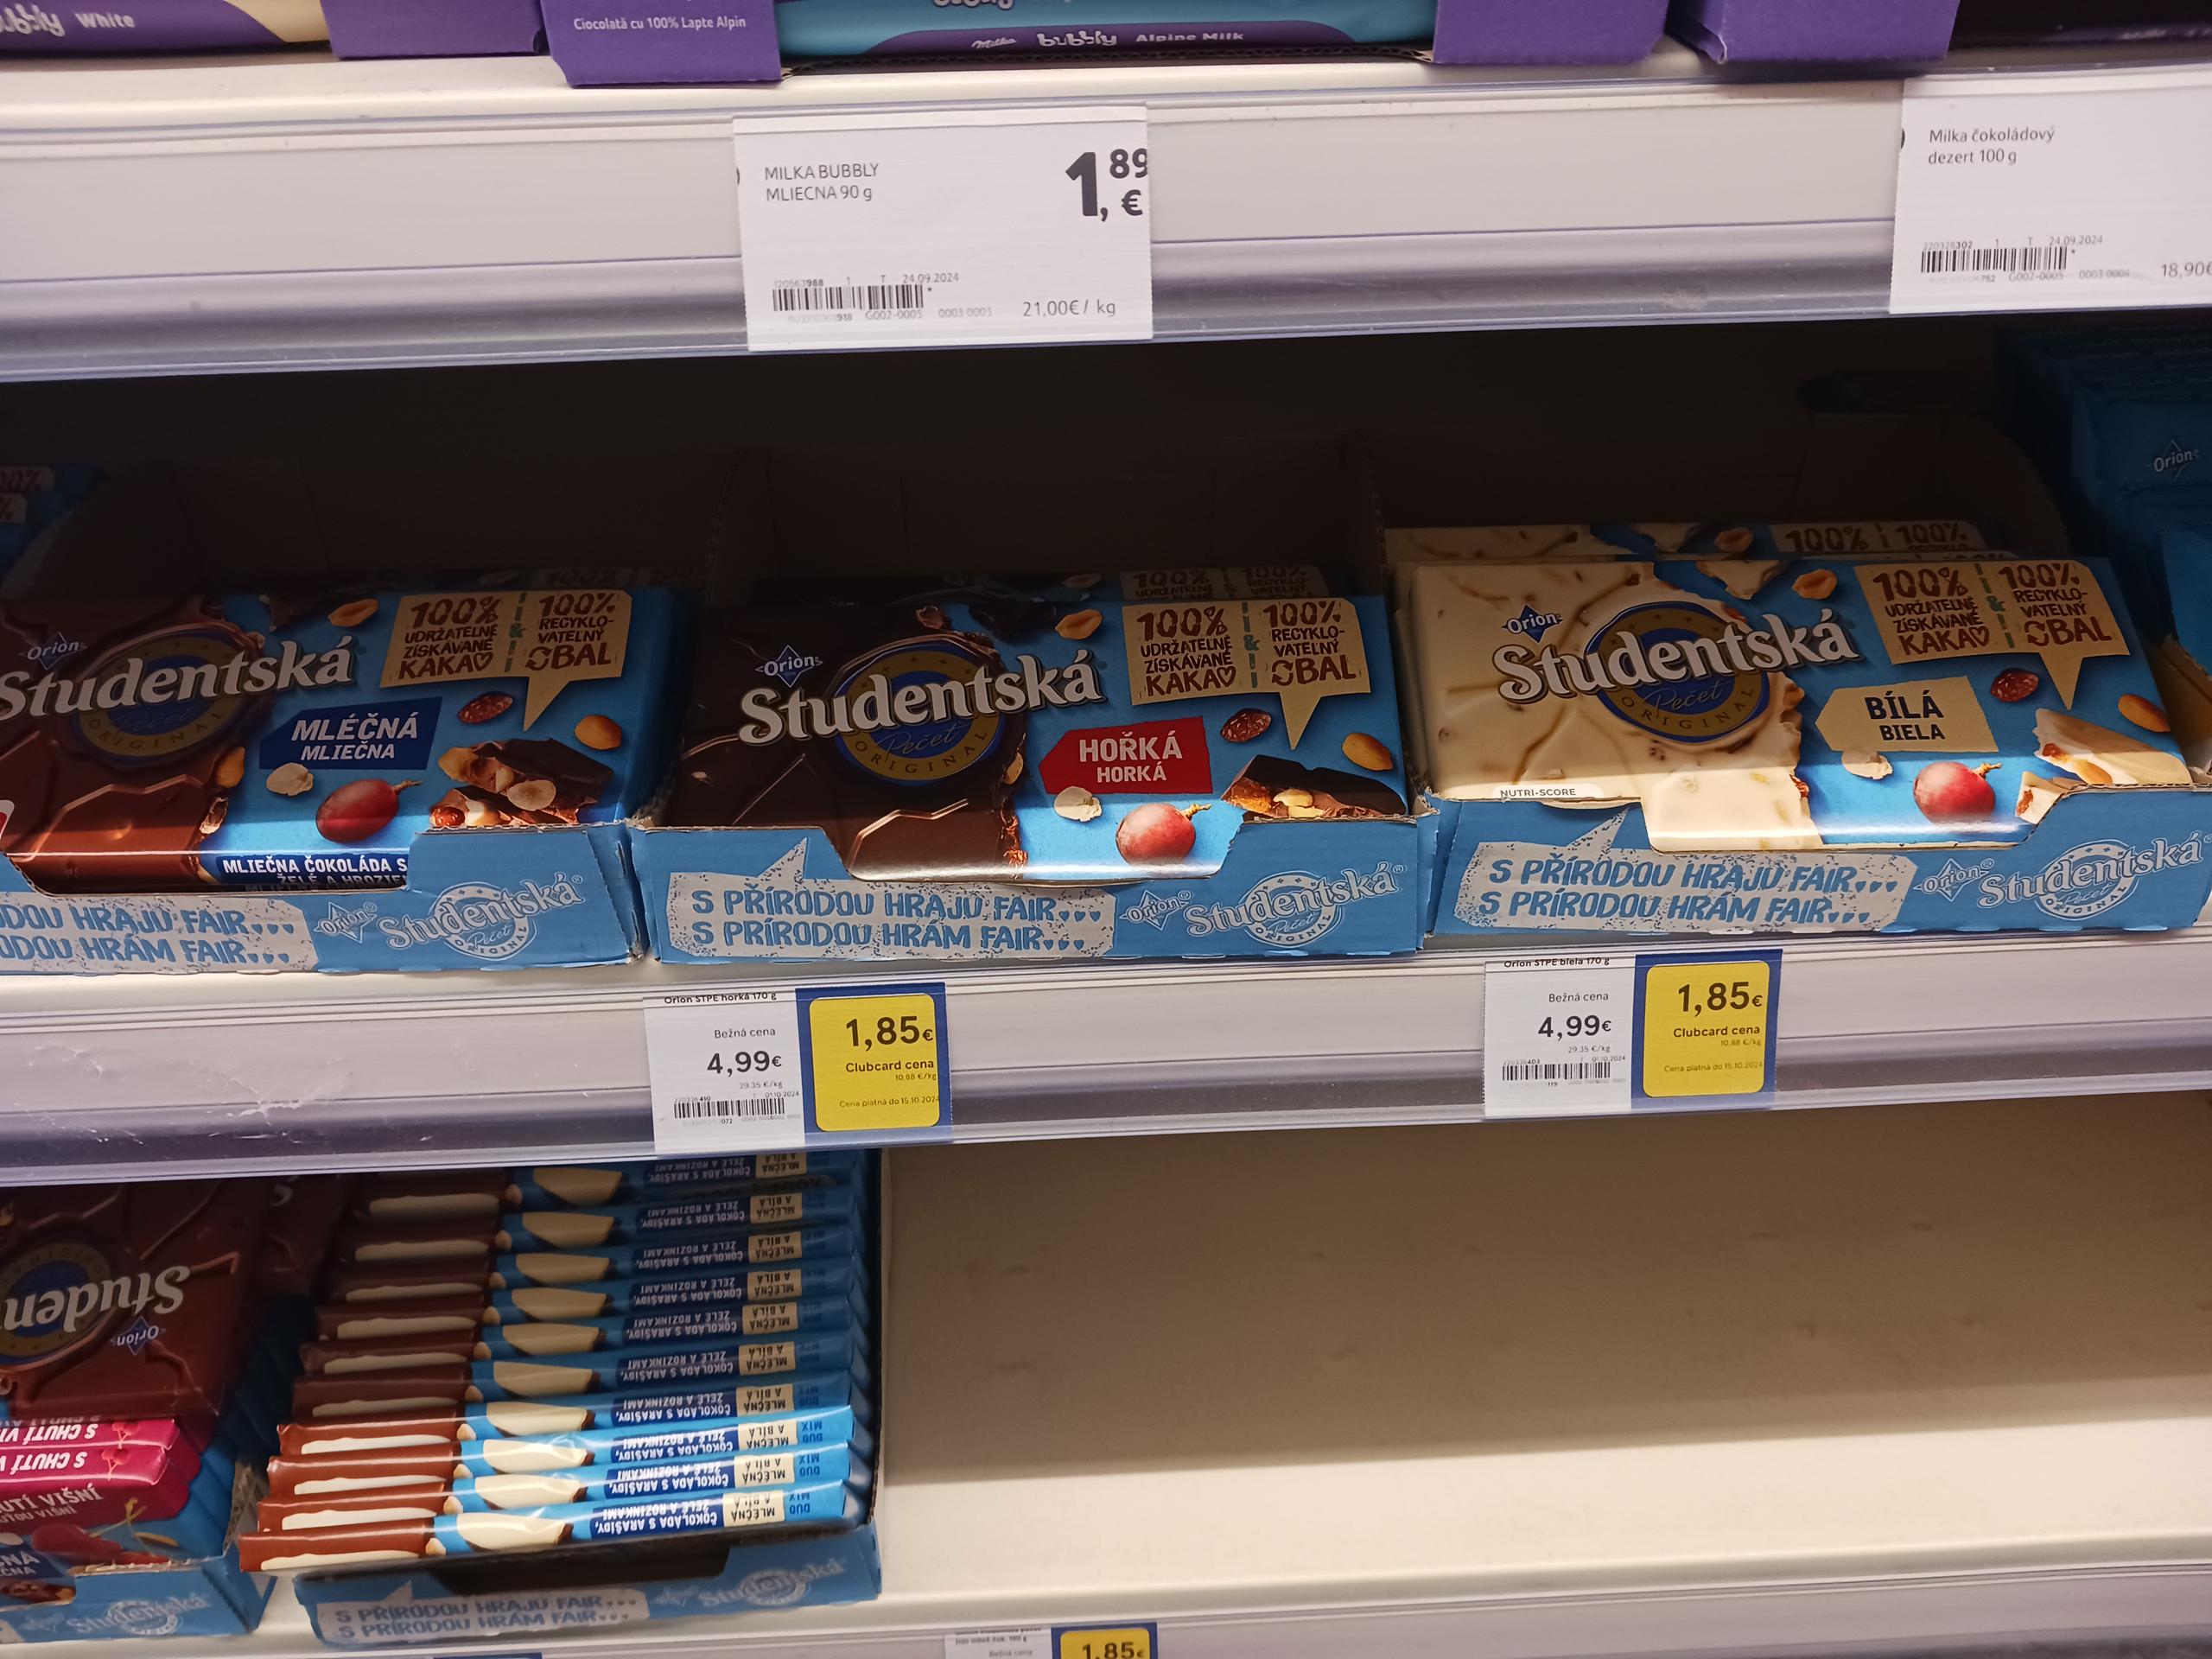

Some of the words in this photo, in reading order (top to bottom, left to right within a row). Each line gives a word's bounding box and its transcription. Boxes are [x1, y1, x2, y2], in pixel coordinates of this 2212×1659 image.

[74, 12, 135, 28] White
[574, 17, 627, 30] Ciocolată
[631, 19, 645, 29] cu
[646, 16, 679, 29] 100%
[681, 16, 714, 31] Lapte
[716, 15, 747, 31] Alpin
[971, 38, 1017, 49] Milka
[1037, 30, 1117, 47] bubbly
[1135, 33, 1198, 42] Alpine
[1202, 32, 1244, 41] Milk
[1929, 129, 1967, 143] Milka
[1972, 125, 2055, 144] čokoládový
[1928, 150, 1974, 164] dezert
[1980, 148, 2005, 162] 100
[2008, 151, 2017, 165] g
[765, 165, 816, 180] MILKA
[818, 162, 879, 179] BUBBLY
[766, 186, 838, 201] MLIECNA
[840, 185, 859, 199] 90
[863, 188, 873, 201] g
[1122, 189, 1143, 216] €
[2049, 235, 2103, 246] 24.09.2024
[903, 273, 959, 284] 24.09.2024
[1097, 299, 1116, 316] kg
[2152, 449, 2193, 473] Orion
[1783, 525, 1867, 552] 100%
[1897, 522, 1967, 543] 100%
[1872, 567, 1968, 601] 100%
[1999, 563, 2080, 589] 100%
[2012, 588, 2088, 603] RECYKLO-
[410, 595, 501, 629] 100%
[538, 593, 615, 617] 100%
[1136, 606, 1228, 641] 100%
[1262, 601, 1341, 628] 100%
[539, 615, 615, 630] RECYKLO-
[1506, 612, 1558, 635] Orion
[1271, 626, 1345, 642] RECYKLO-
[27, 640, 79, 662] Orion
[1493, 608, 1859, 704] Studentská
[764, 656, 816, 677] Orion
[0, 636, 354, 721] Studentská
[738, 649, 1103, 745] Studentská
[1865, 690, 1944, 720] BÍLÁ
[1620, 688, 1756, 730] ORIGINAL
[291, 712, 419, 741] MLÉČNÁ
[1879, 724, 1945, 741] BIELA
[300, 741, 395, 761] MLIEČNA
[855, 732, 988, 775] ORIGINAL
[1078, 730, 1183, 764] HOŘKÁ
[1096, 761, 1167, 783] HORKÁ
[1499, 786, 1576, 798] NUTRI-SCORE
[223, 856, 301, 874] MLIEČNA
[304, 855, 392, 874] ČOKOLÁDA
[397, 860, 408, 872] S
[1490, 859, 1514, 884] S
[1521, 853, 1673, 887] PŘÍRODOU
[1789, 866, 1858, 893] FAIR
[1977, 830, 2202, 908] Studentská
[1922, 866, 1981, 894] Orion
[691, 889, 715, 914] S
[724, 882, 874, 917] PŘÍRODOU
[993, 895, 1058, 923] FAIR
[1124, 895, 1181, 924] Orion
[1183, 861, 1401, 936] Studentská
[1478, 890, 1501, 915] S
[1510, 887, 1659, 918] PRÍRODOU
[1667, 892, 1755, 922] HRÁM
[1766, 896, 1832, 923] FAIR
[378, 871, 585, 949] Studentská
[181, 909, 246, 935] FAIR
[318, 908, 370, 935] Orion
[692, 920, 715, 945] S
[724, 917, 871, 948] PRÍRODOU
[882, 921, 971, 950] HRÁM
[980, 925, 1044, 951] FAIR
[79, 933, 177, 963] HRÁM
[179, 938, 246, 963] FAIR
[1534, 957, 1557, 966] STPE
[695, 994, 719, 1003] STPE
[721, 992, 750, 1002] horká
[753, 991, 768, 1001] 170
[770, 992, 777, 1001] g
[1548, 991, 1580, 1002] Bežná
[1583, 992, 1609, 1001] cena
[1678, 982, 1763, 1017] 1,85€
[714, 1027, 747, 1039] Bežná
[749, 1027, 776, 1037] cena
[845, 1015, 934, 1052] 1,85€
[1537, 1014, 1611, 1040] 4,99€
[1673, 1026, 1727, 1038] Clubcard
[1731, 1025, 1760, 1035] cena
[707, 1050, 782, 1077] 4,99€
[845, 1060, 901, 1073] Clubcard
[905, 1060, 935, 1071] cena
[0, 1265, 191, 1332] Studen
[117, 1324, 159, 1346] Orion
[84, 1423, 99, 1439] S
[10, 1452, 71, 1475] CHUTÍ
[73, 1452, 87, 1467] S
[742, 1469, 786, 1484] MLÉČNÁ
[799, 1466, 821, 1477] DUO
[38, 1483, 104, 1506] VIŠNÍ
[731, 1506, 775, 1520] MLÉČNÁ
[789, 1503, 810, 1514] DUO
[660, 1511, 718, 1530] ČOKOLÁDA
